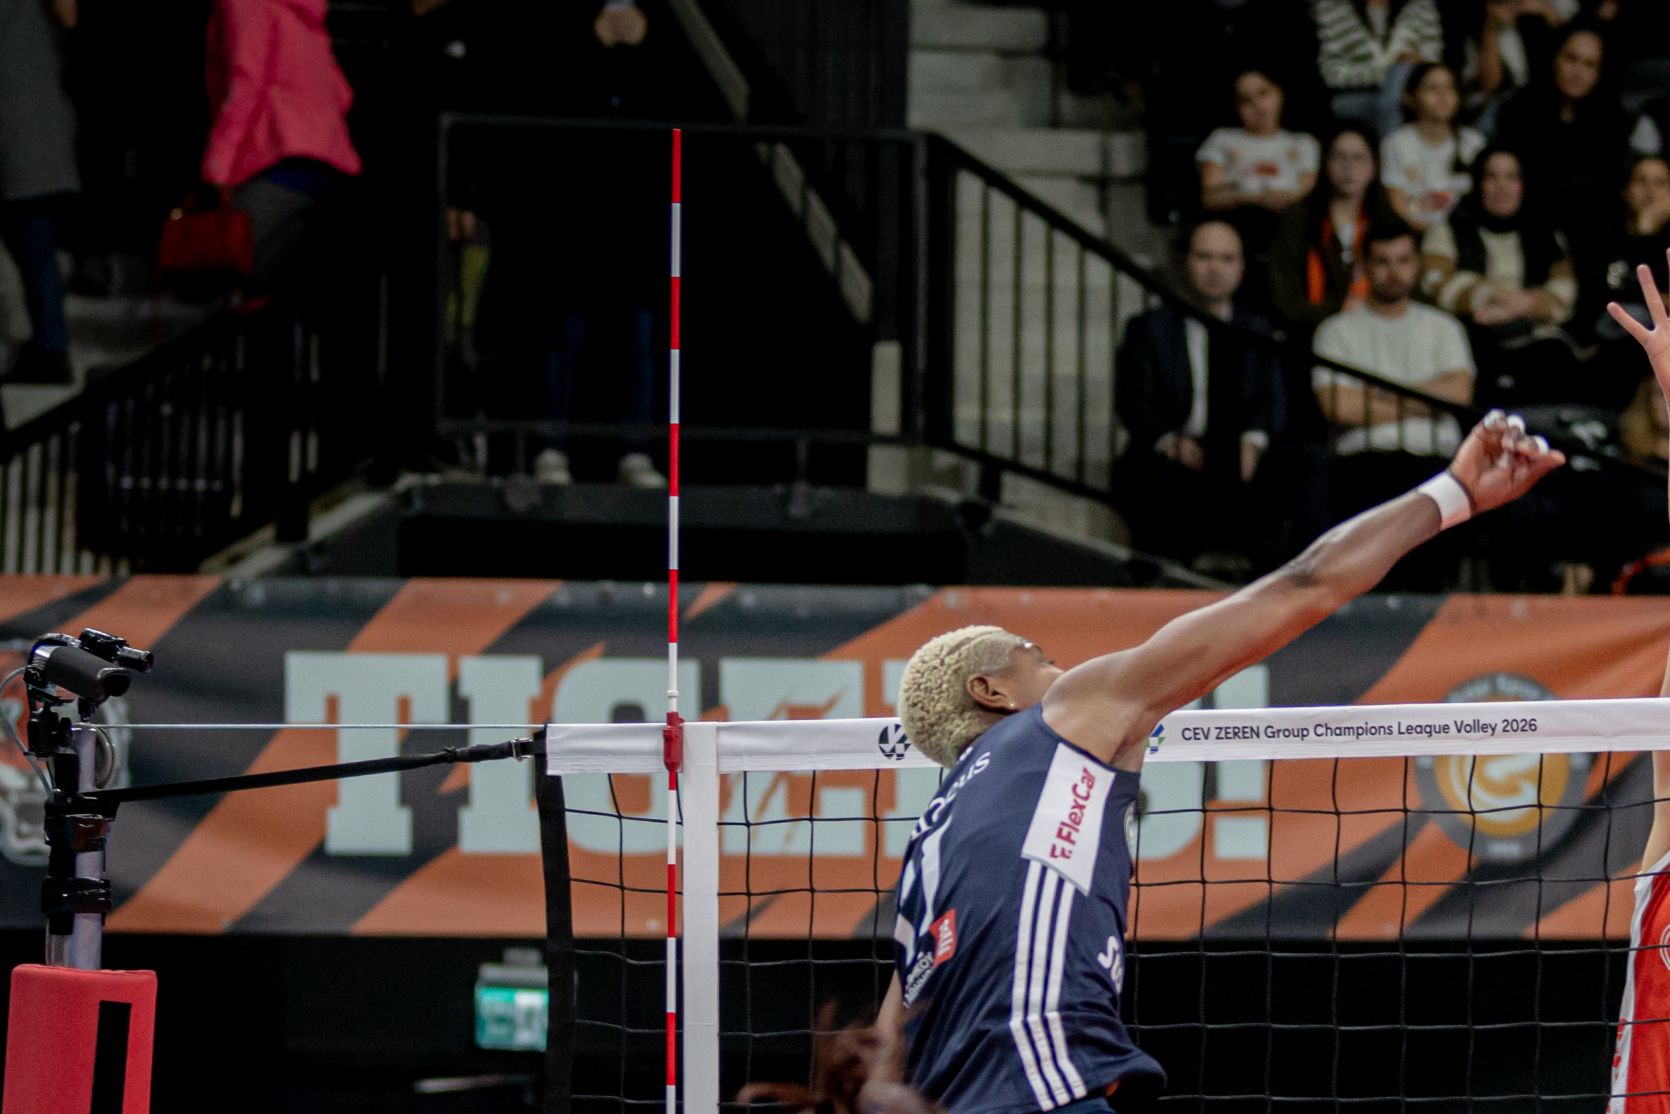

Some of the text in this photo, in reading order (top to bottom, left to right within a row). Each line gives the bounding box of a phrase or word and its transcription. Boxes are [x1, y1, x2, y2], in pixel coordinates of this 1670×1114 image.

[285, 651, 1270, 860] TIGE!
[1180, 718, 1538, 742] CEV ZEREN Group Champions League Volley 2026
[1056, 766, 1097, 847] FlexCar
